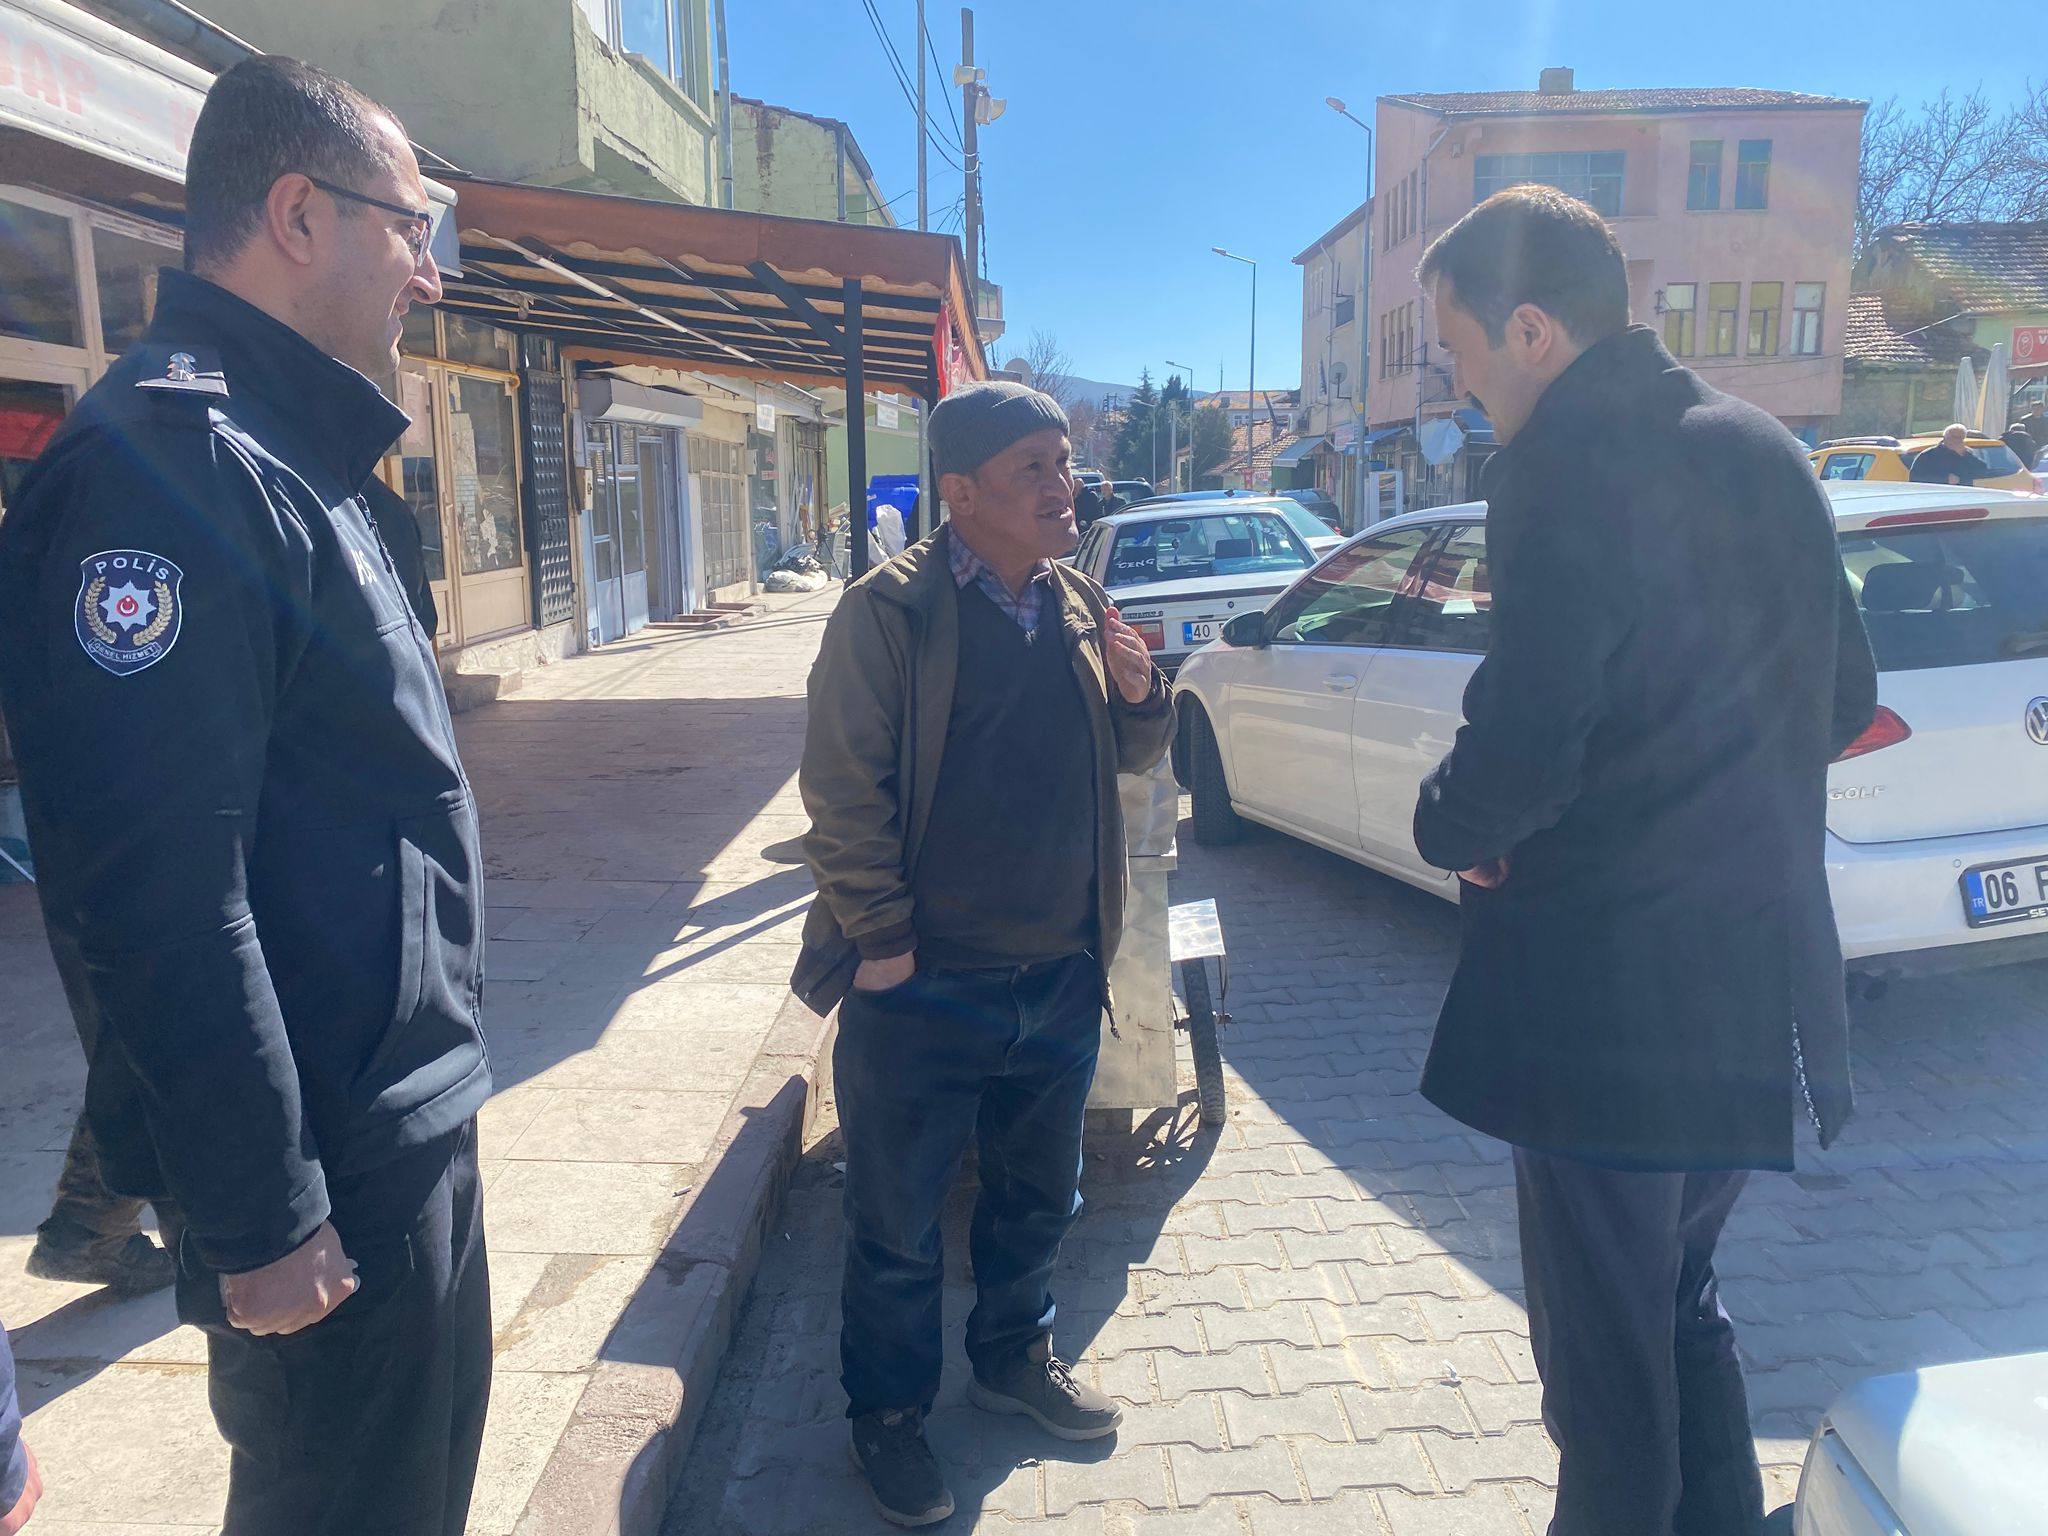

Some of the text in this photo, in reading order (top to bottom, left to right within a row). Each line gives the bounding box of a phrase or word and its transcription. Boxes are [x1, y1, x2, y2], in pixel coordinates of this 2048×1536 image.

[95, 557, 169, 580] POLİS
[1194, 624, 1210, 638] 40
[1828, 784, 1886, 800] GOLF
[1985, 871, 2019, 909] 06
[1973, 897, 1985, 908] TR
[2029, 906, 2048, 919] SE
